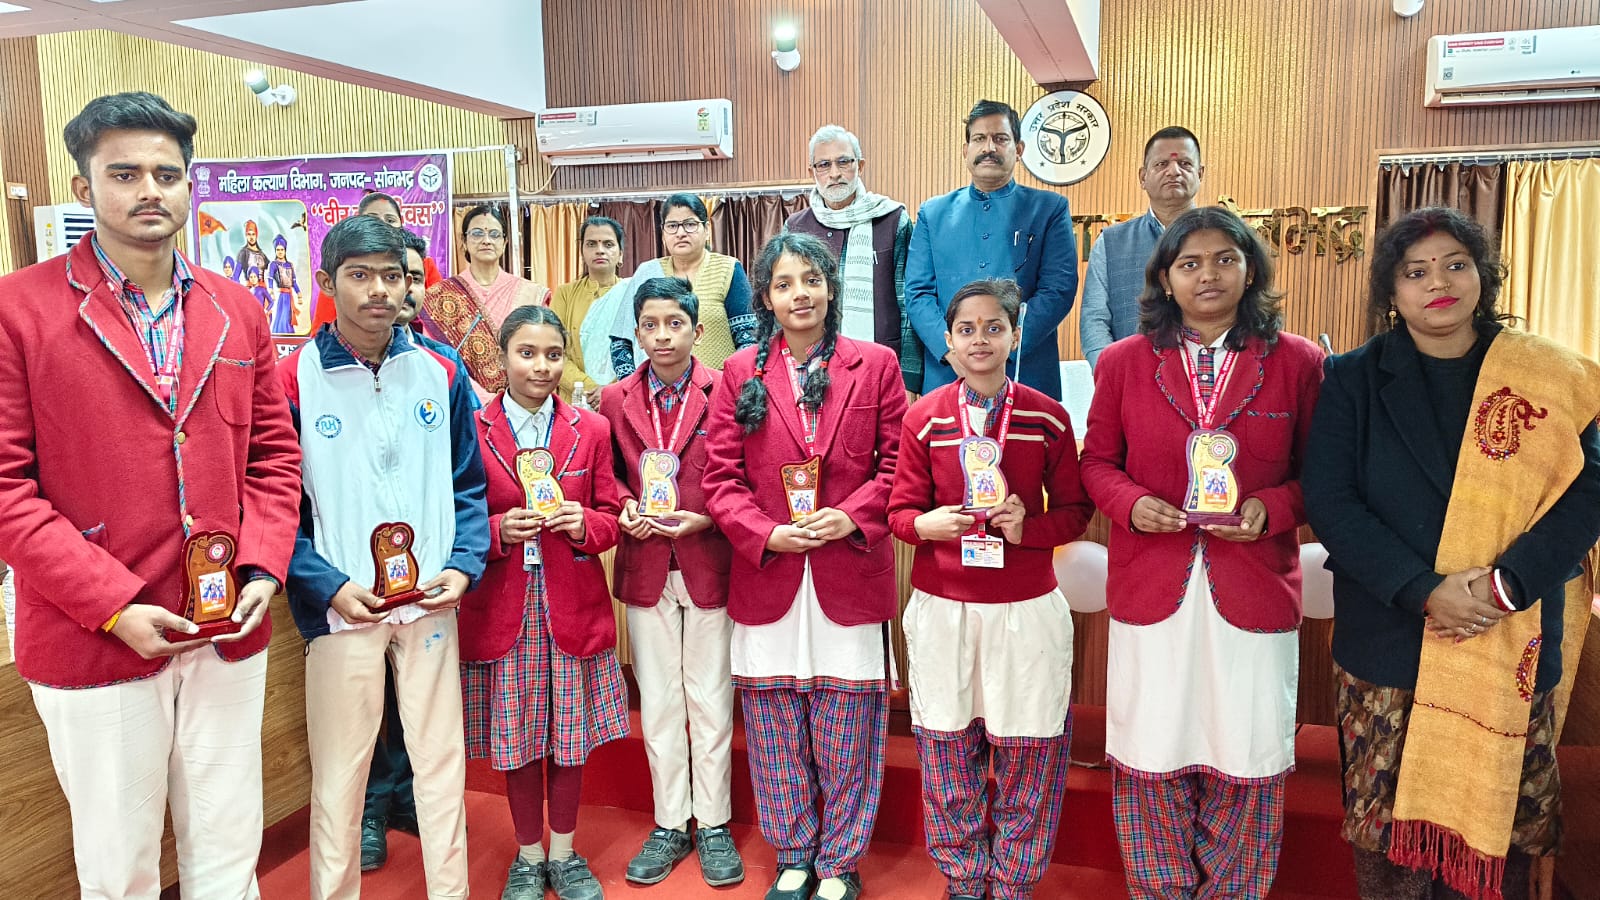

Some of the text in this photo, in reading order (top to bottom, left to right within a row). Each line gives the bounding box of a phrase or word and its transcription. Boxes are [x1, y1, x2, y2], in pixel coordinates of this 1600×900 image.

[1047, 99, 1071, 113] प्रदेश
[1076, 103, 1100, 128] सरकार
[217, 165, 415, 194] महिला कल्याण विभाग, जनपद- सोनभद्र
[1208, 393, 1218, 413] PUBLIC
